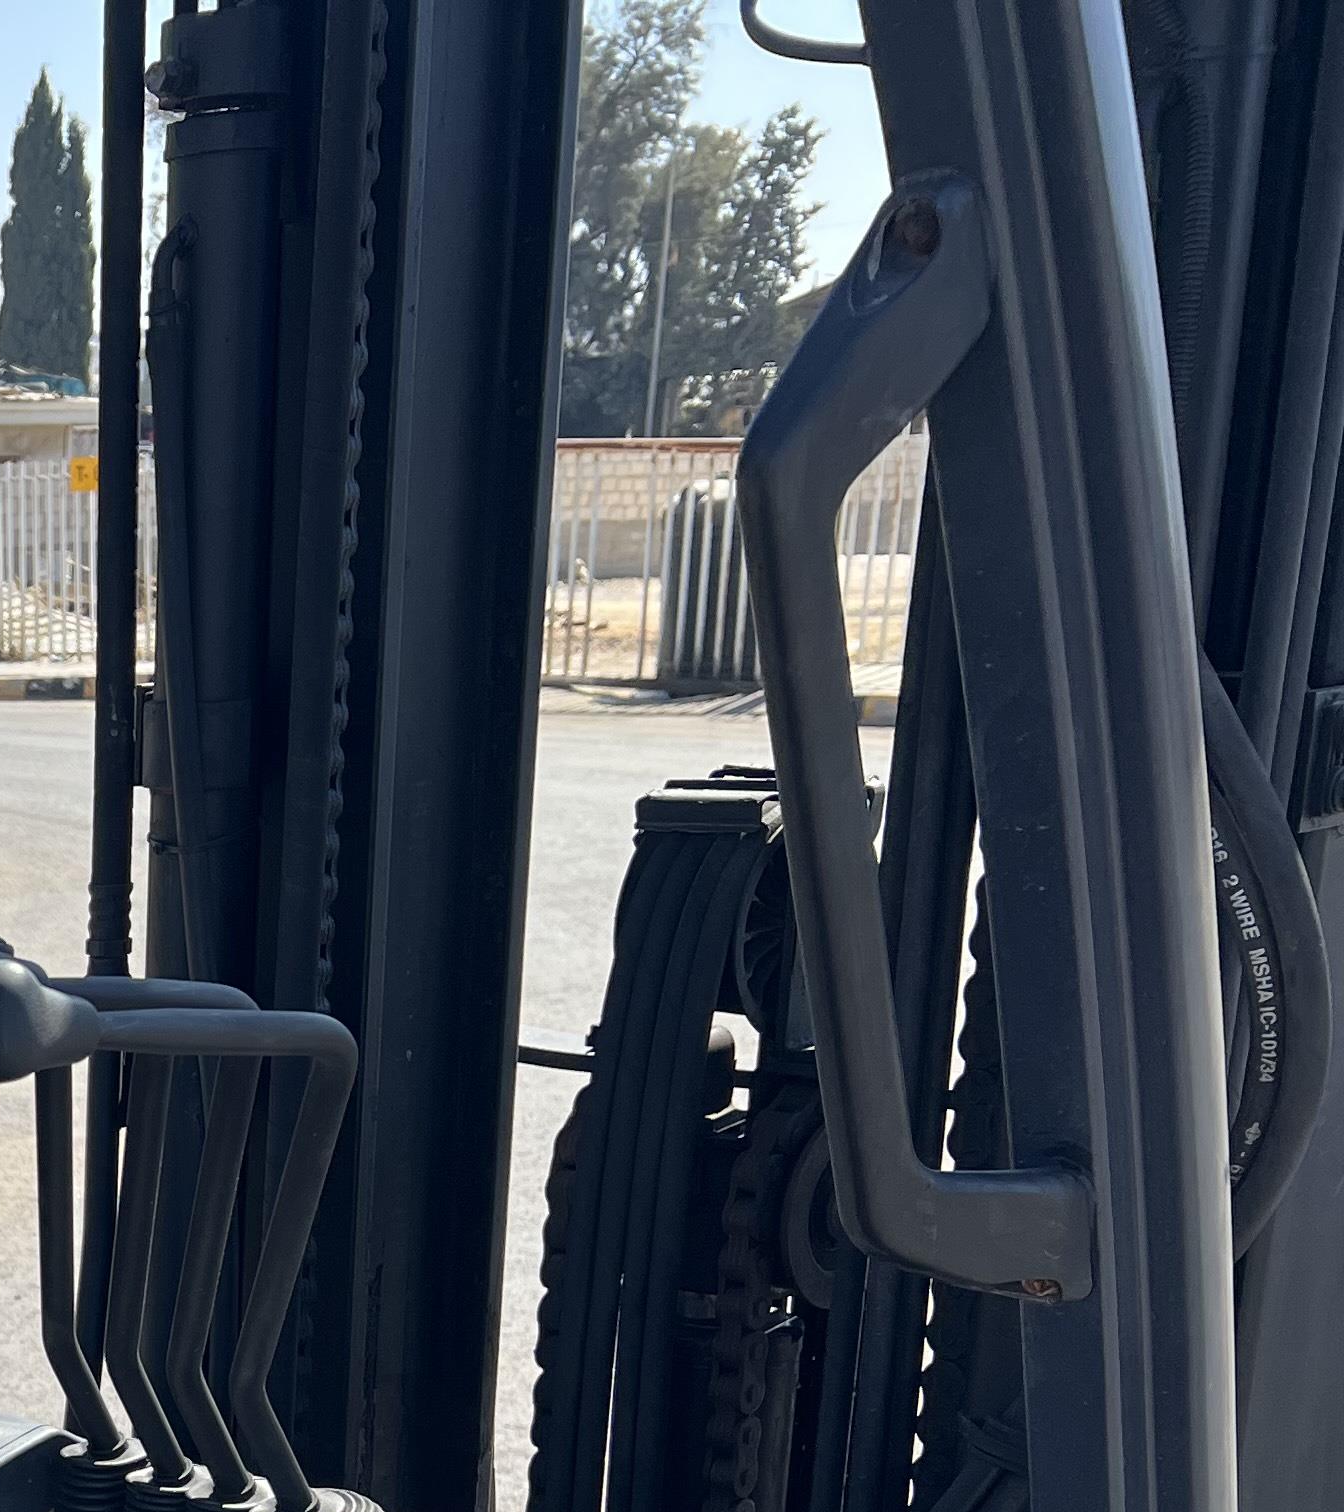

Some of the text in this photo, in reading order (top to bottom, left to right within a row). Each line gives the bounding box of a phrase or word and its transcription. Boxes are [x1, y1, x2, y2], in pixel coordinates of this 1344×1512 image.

[1222, 874, 1239, 889] 2
[1229, 889, 1261, 941] WIRE
[1248, 947, 1275, 1003] MSHA
